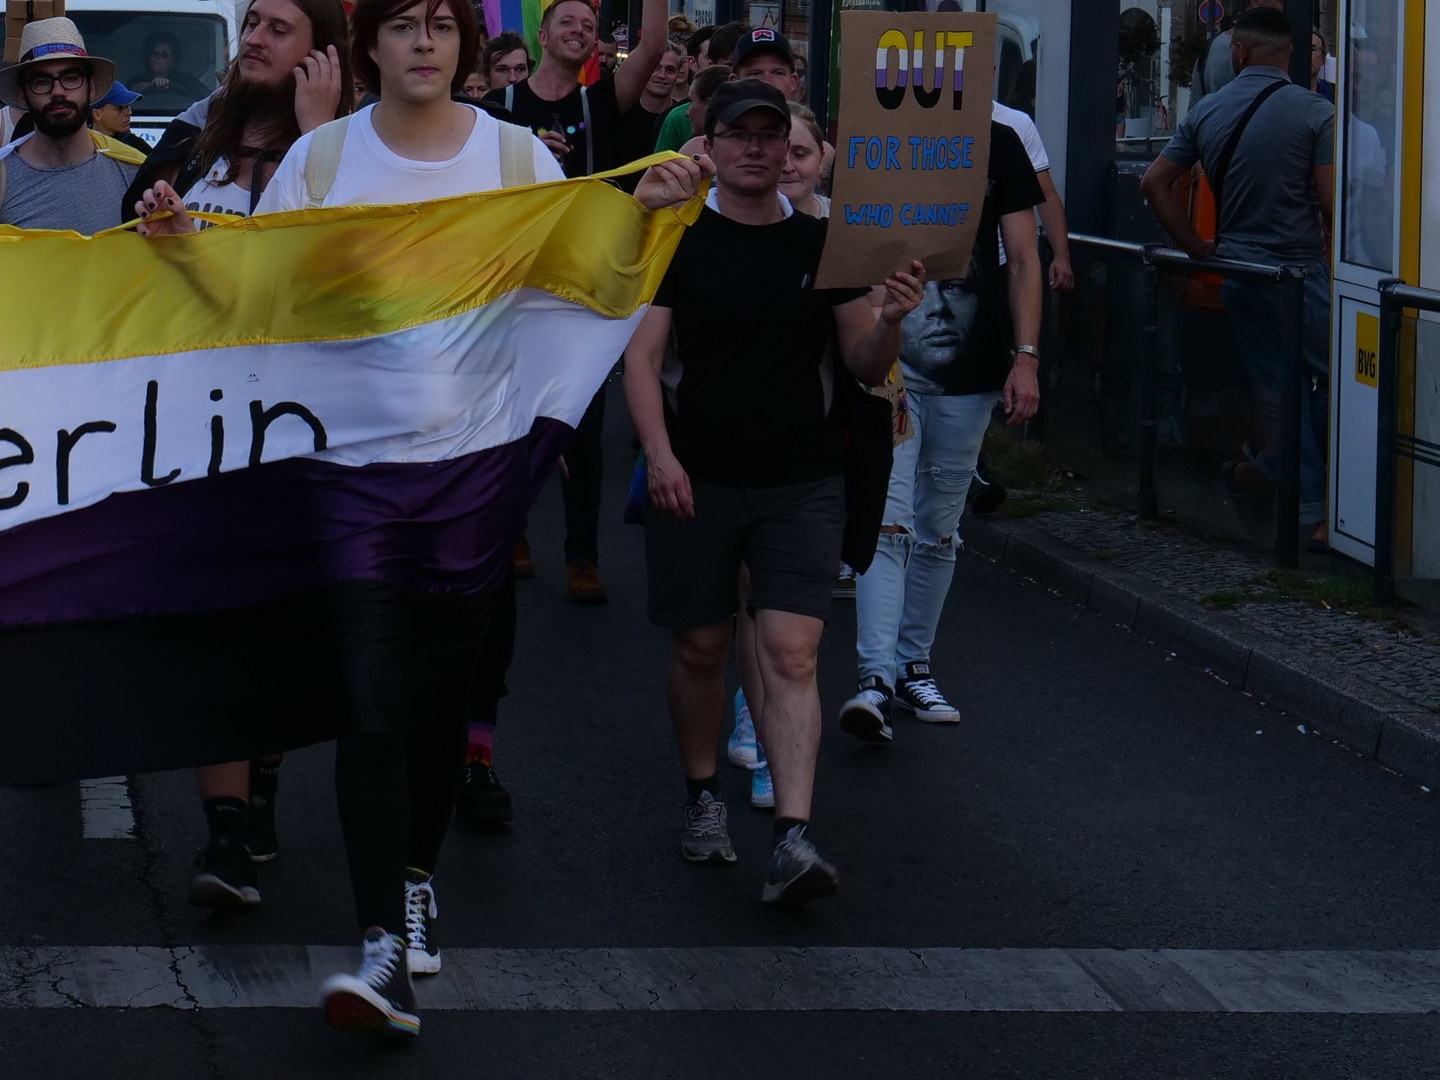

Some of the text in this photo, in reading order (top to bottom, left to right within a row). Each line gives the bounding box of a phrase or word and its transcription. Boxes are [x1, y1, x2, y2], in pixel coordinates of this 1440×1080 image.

[875, 28, 974, 110] OUT
[847, 136, 975, 170] FOR THOSE
[844, 202, 970, 229] WHO CANNOT
[1357, 348, 1376, 379] BVG
